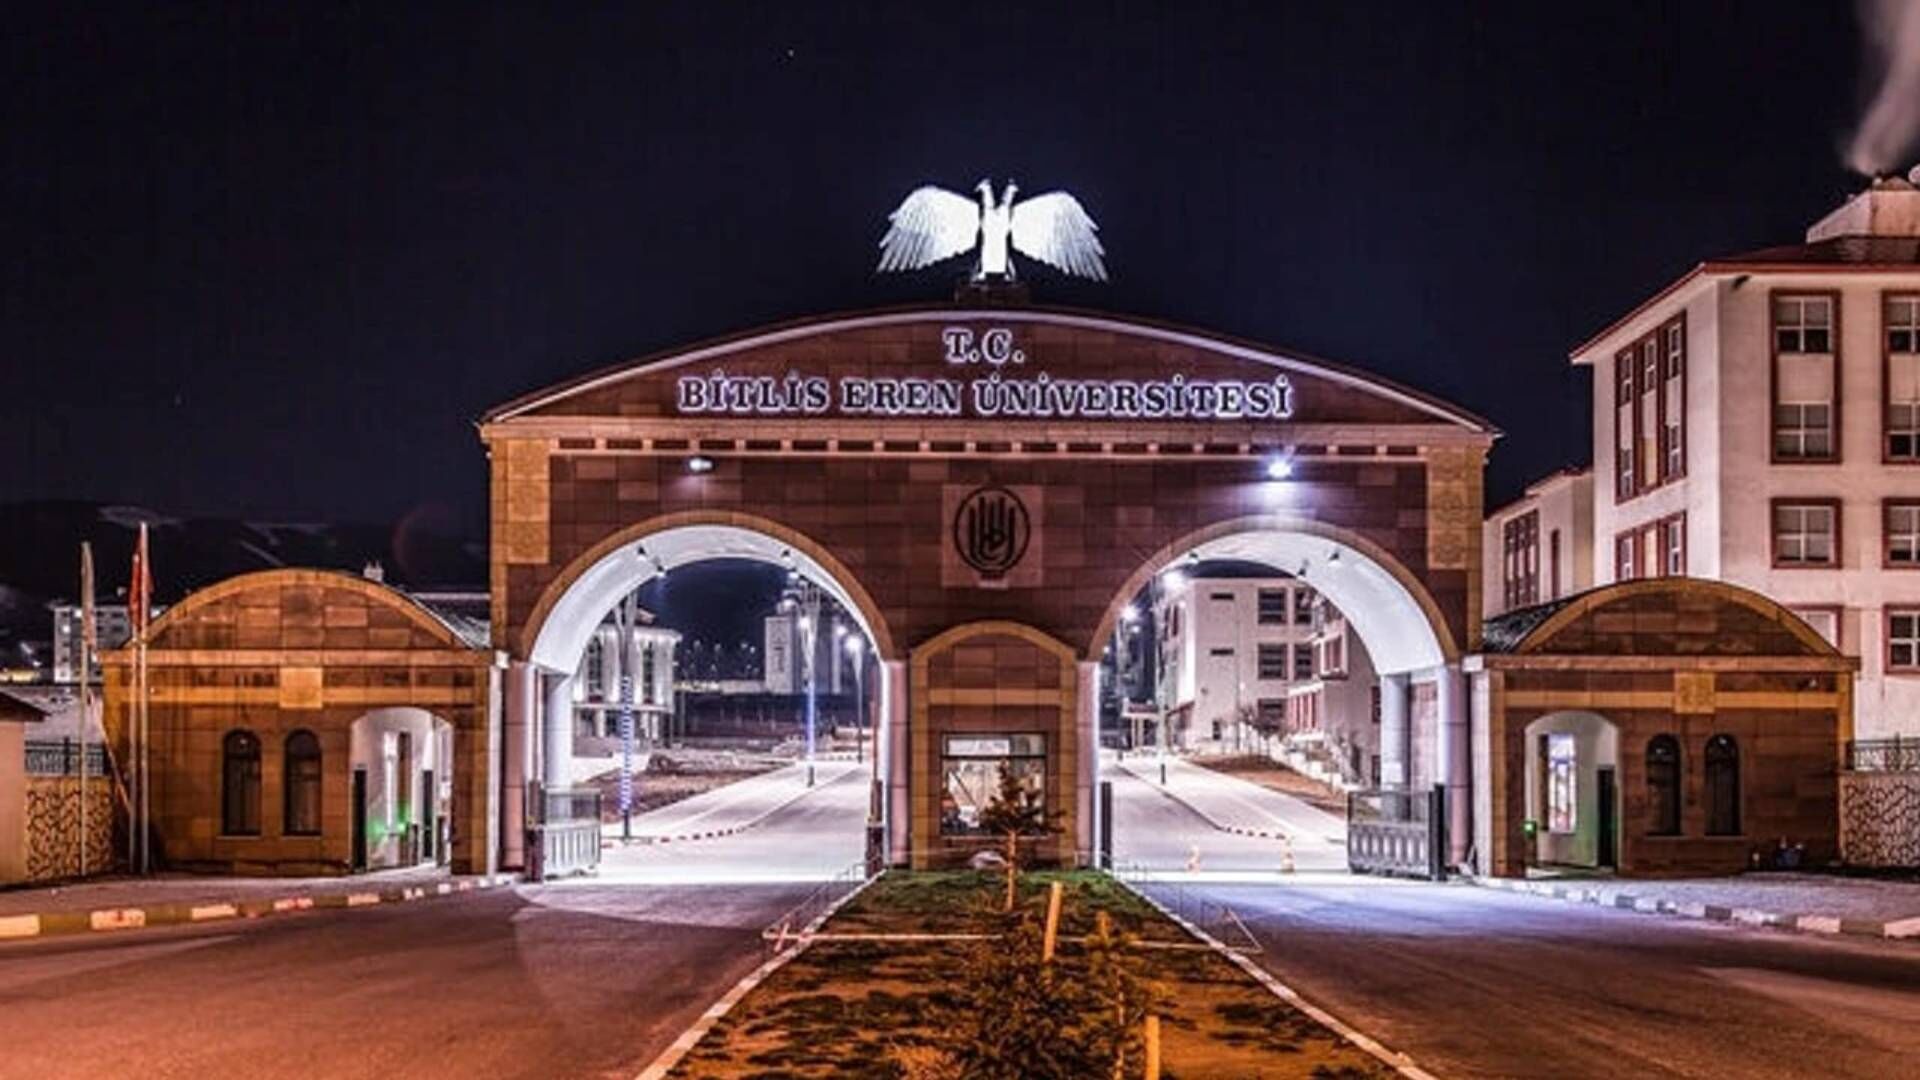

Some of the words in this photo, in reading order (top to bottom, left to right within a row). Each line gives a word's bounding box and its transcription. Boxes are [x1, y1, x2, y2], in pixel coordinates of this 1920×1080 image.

[943, 328, 1025, 364] T.C.
[678, 369, 829, 412] BİTLİS
[839, 377, 963, 414] EREN
